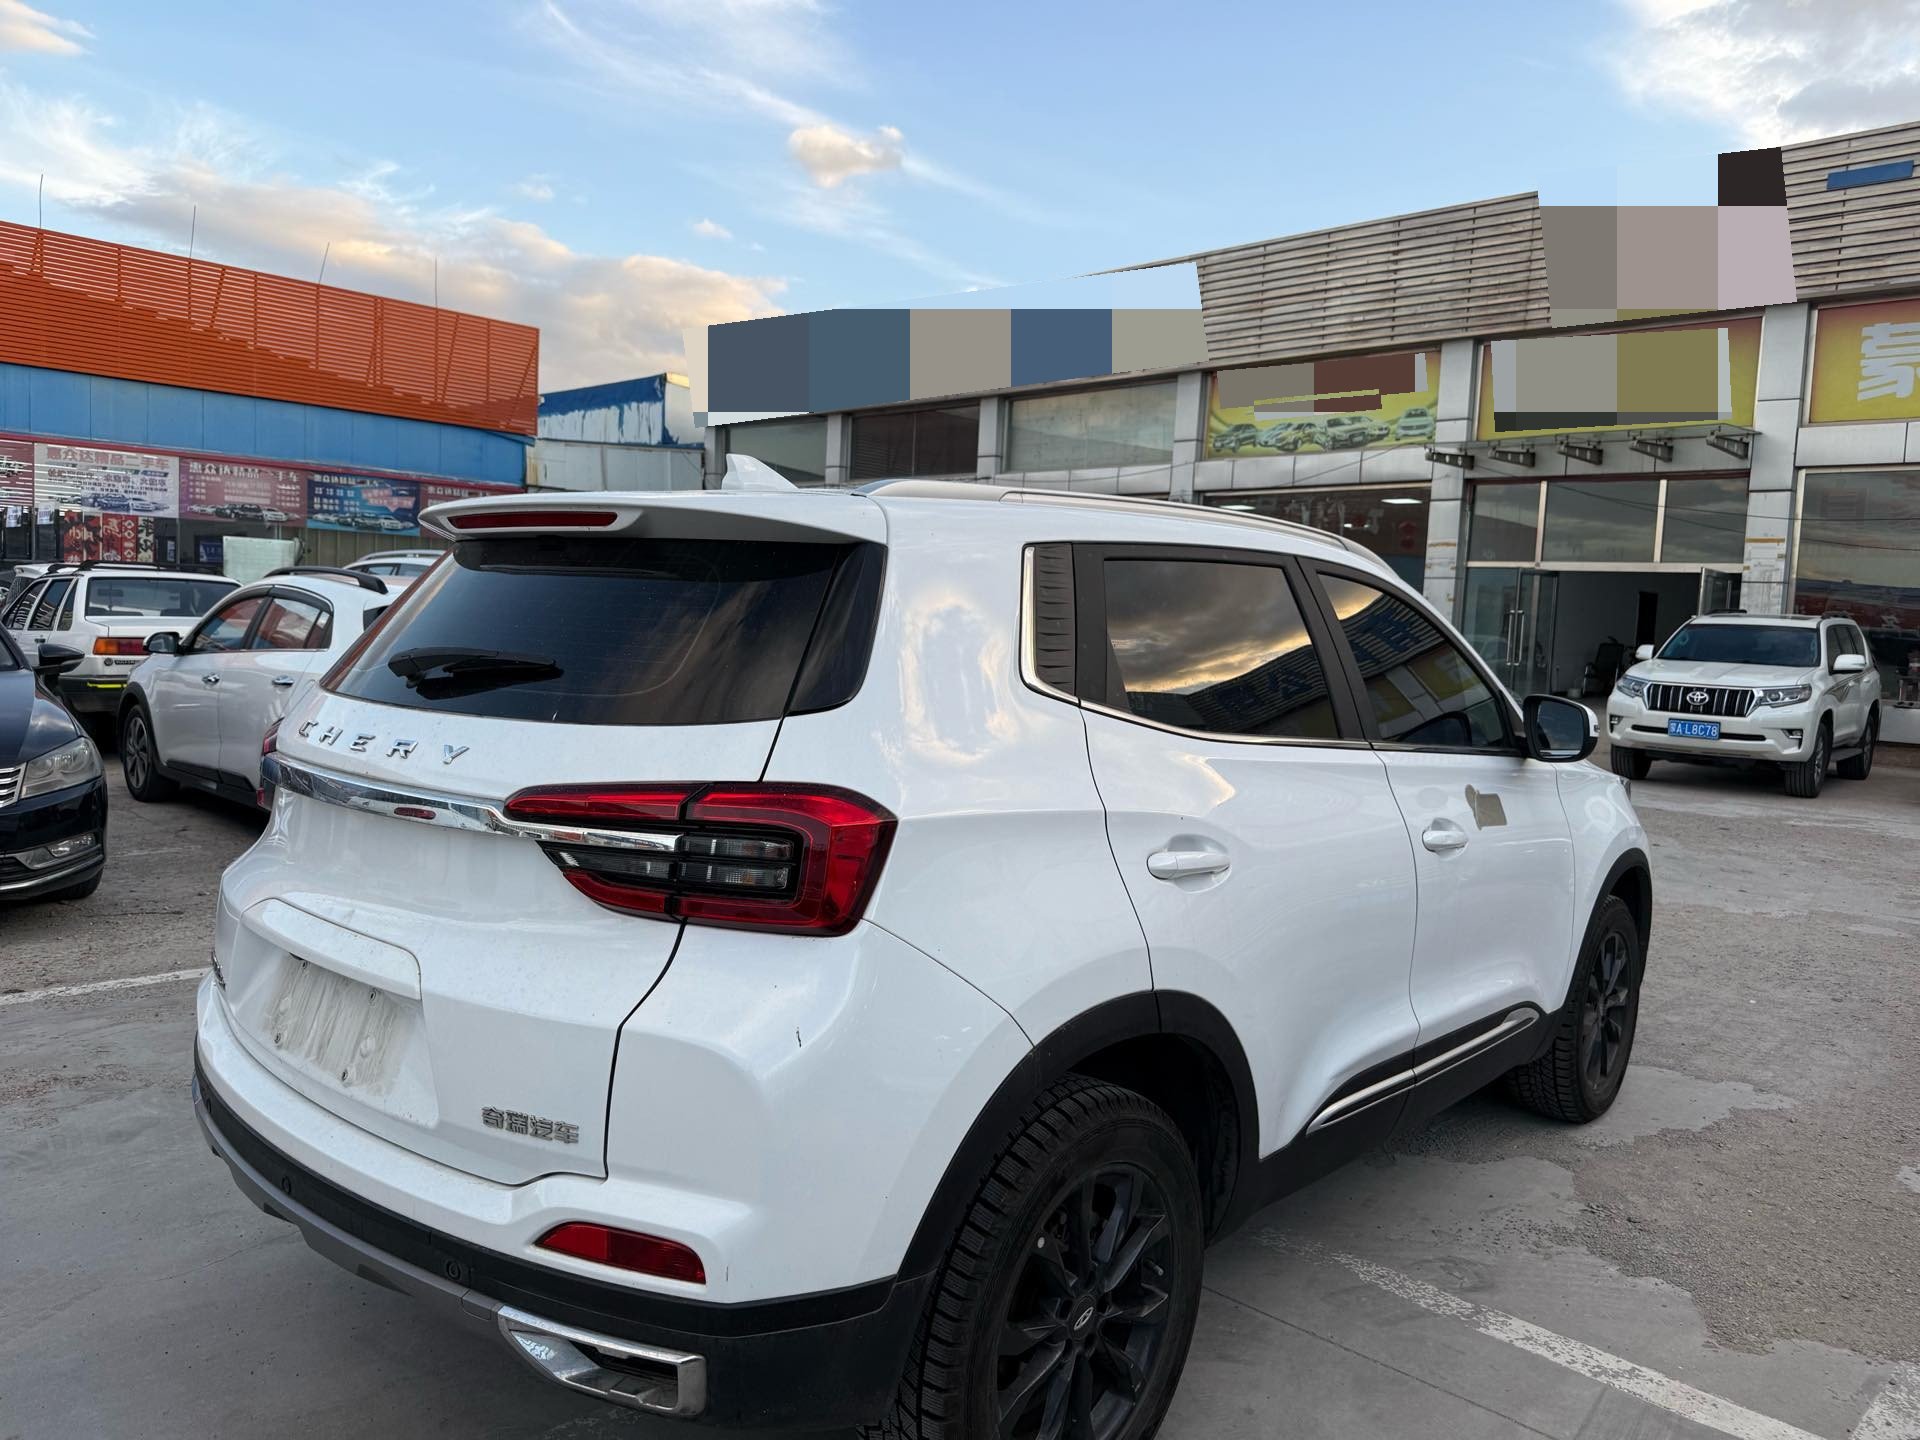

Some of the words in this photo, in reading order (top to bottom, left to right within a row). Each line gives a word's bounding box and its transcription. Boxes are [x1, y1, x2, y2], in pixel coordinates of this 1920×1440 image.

[299, 720, 470, 765] CHERY
[481, 1106, 580, 1144] 奇瑞汽车
